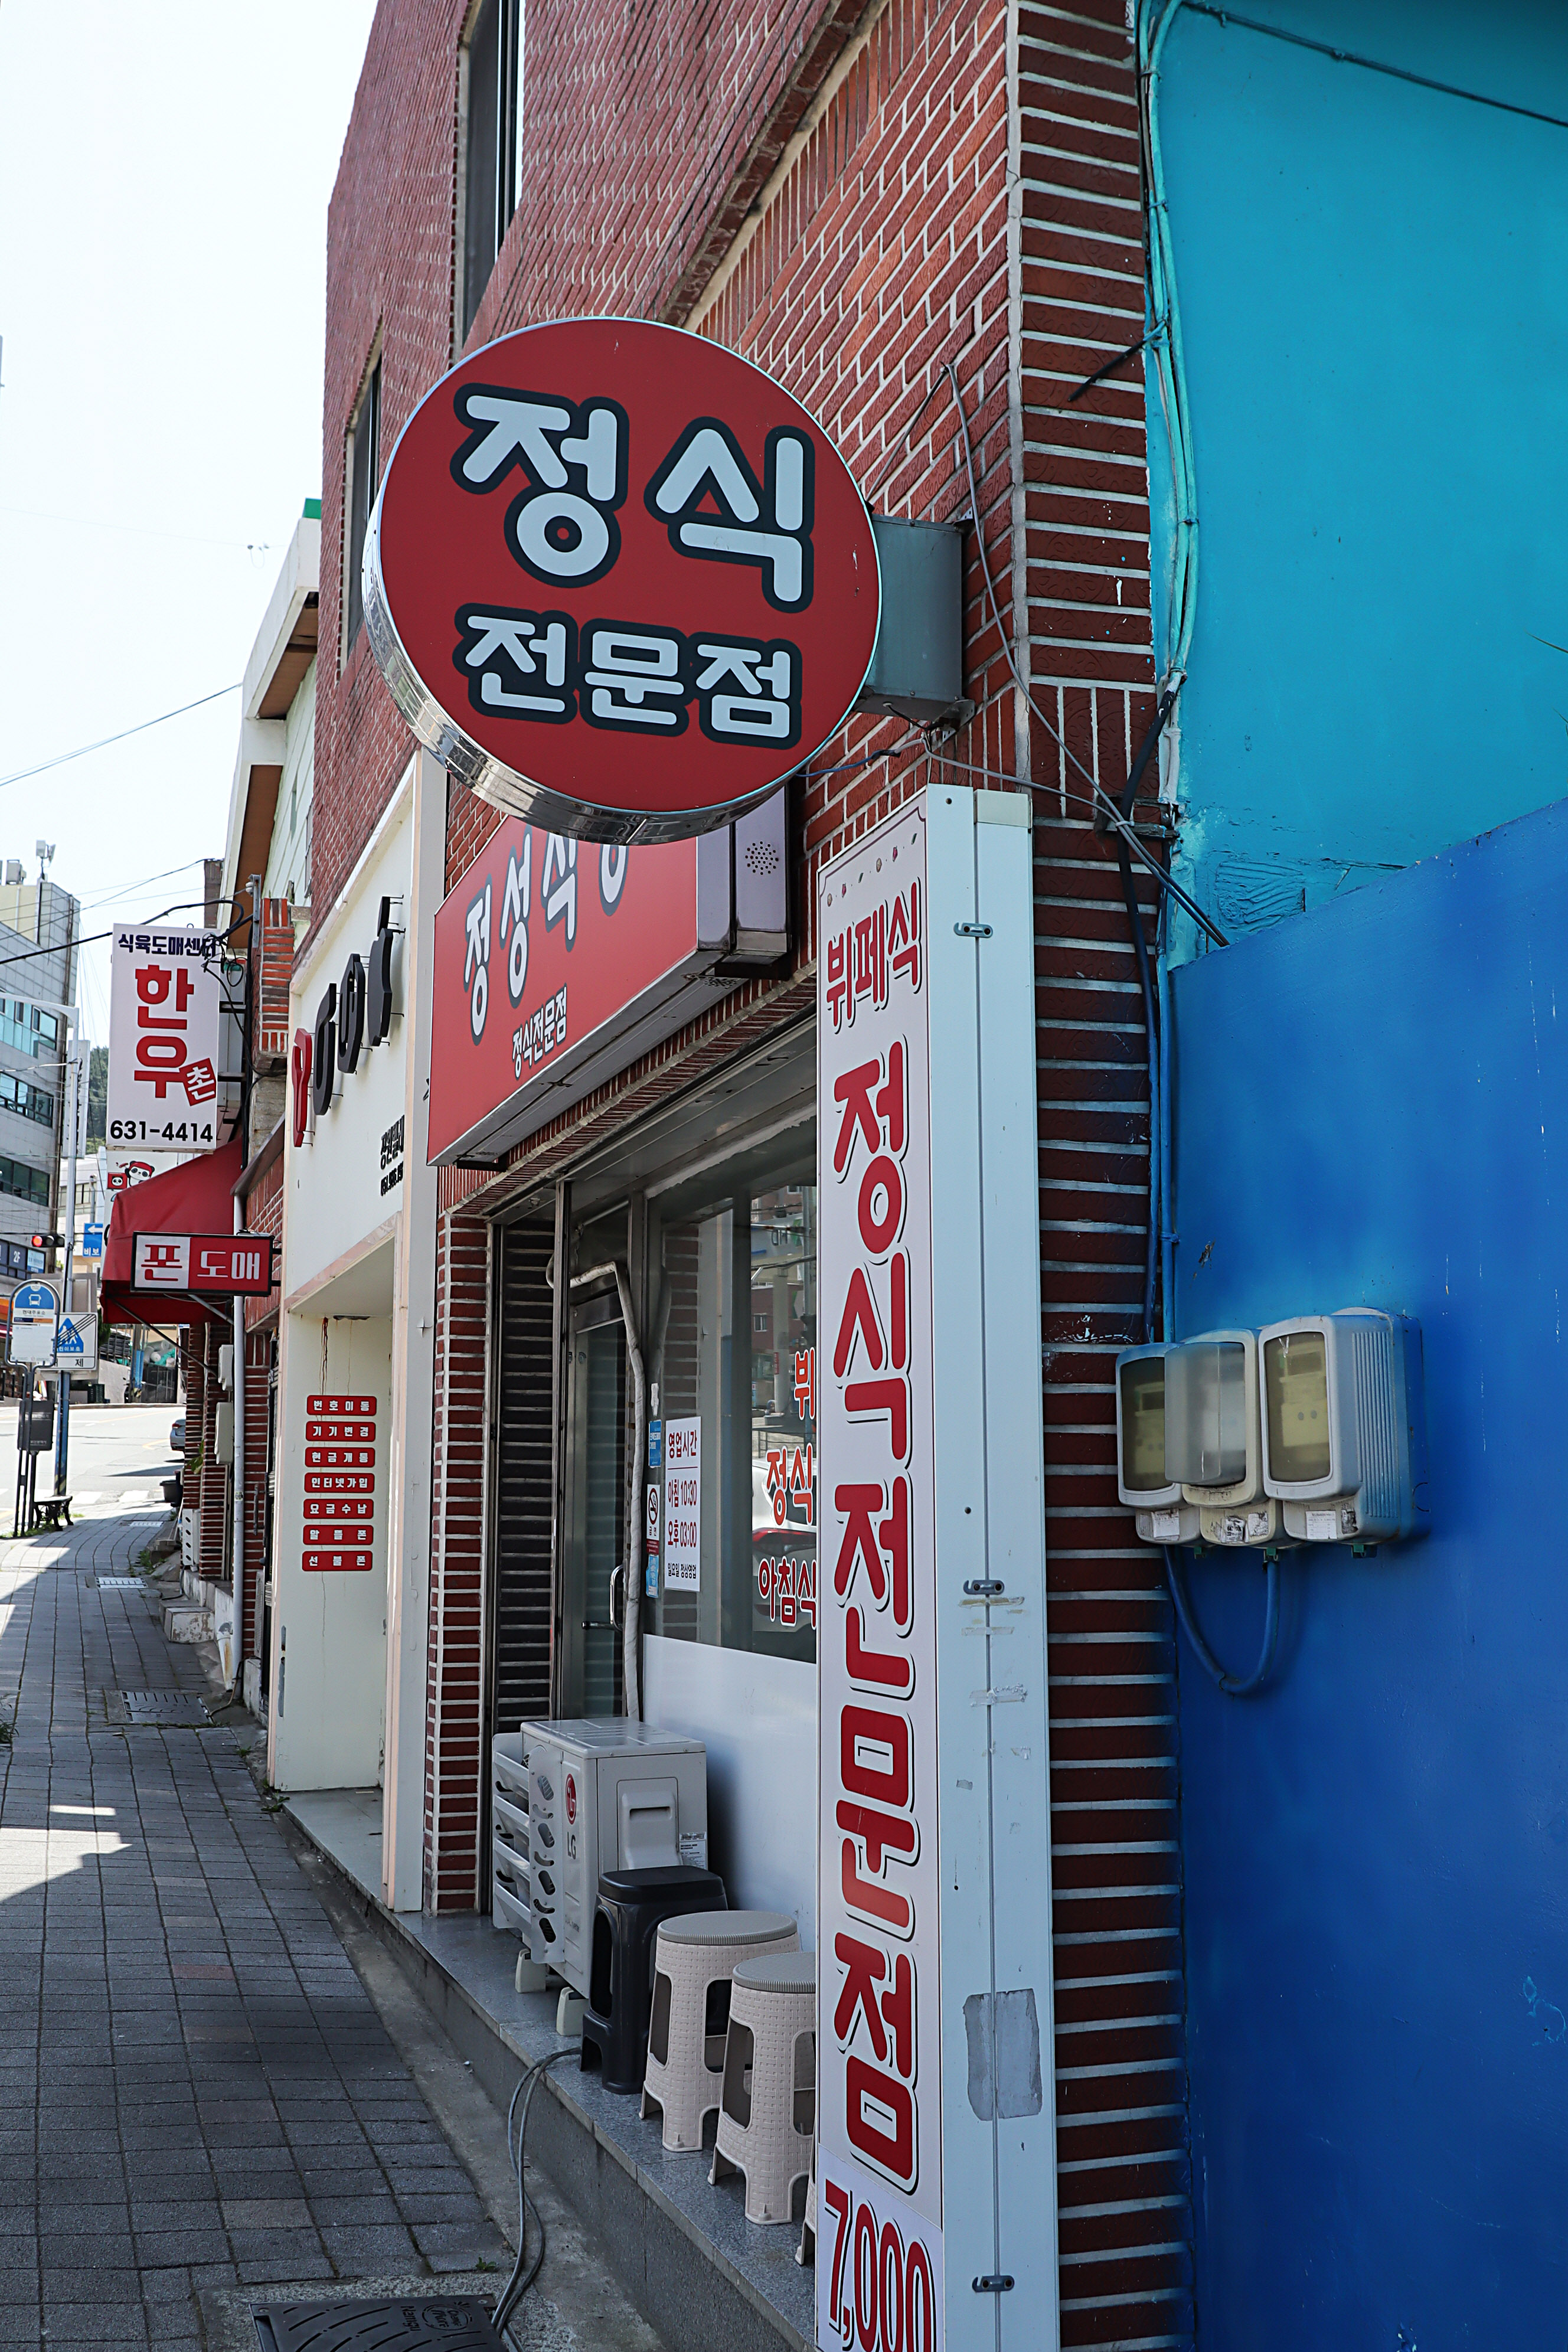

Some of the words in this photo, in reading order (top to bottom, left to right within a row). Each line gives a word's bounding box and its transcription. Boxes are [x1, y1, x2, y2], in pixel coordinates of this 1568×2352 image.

[462, 394, 804, 603] 정식
[465, 615, 792, 739] 전문점
[118, 933, 217, 957] 식육도매센터
[464, 831, 629, 1038] 정성식
[826, 881, 920, 1028] 뷔페식
[512, 986, 568, 1080] 정식전문점
[110, 1121, 213, 1142] 631-4414
[13, 1250, 21, 1263] 2F
[141, 1244, 182, 1282] 폰
[197, 1250, 260, 1280] 도매
[313, 1400, 370, 1412] 번호이동
[312, 1426, 369, 1437] 기기변경
[668, 1429, 697, 1459] 영업시간
[312, 1451, 368, 1463] 현금개통
[311, 1477, 368, 1488] 인터넷가입
[668, 1479, 680, 1508] 아침
[681, 1479, 697, 1506] 10:30
[766, 1442, 814, 1526] 정식
[309, 1503, 367, 1514] 요금수납
[668, 1519, 679, 1549] 오후
[680, 1521, 697, 1548] 03:00
[309, 1555, 366, 1566] 선불폰
[668, 1562, 680, 1577] 일요일
[680, 1563, 697, 1579] 정상영업
[759, 1556, 816, 1630] 아침식
[833, 1040, 919, 2182] 정식전문점
[567, 1831, 576, 1860] LG
[825, 2177, 940, 2352] 7,000
